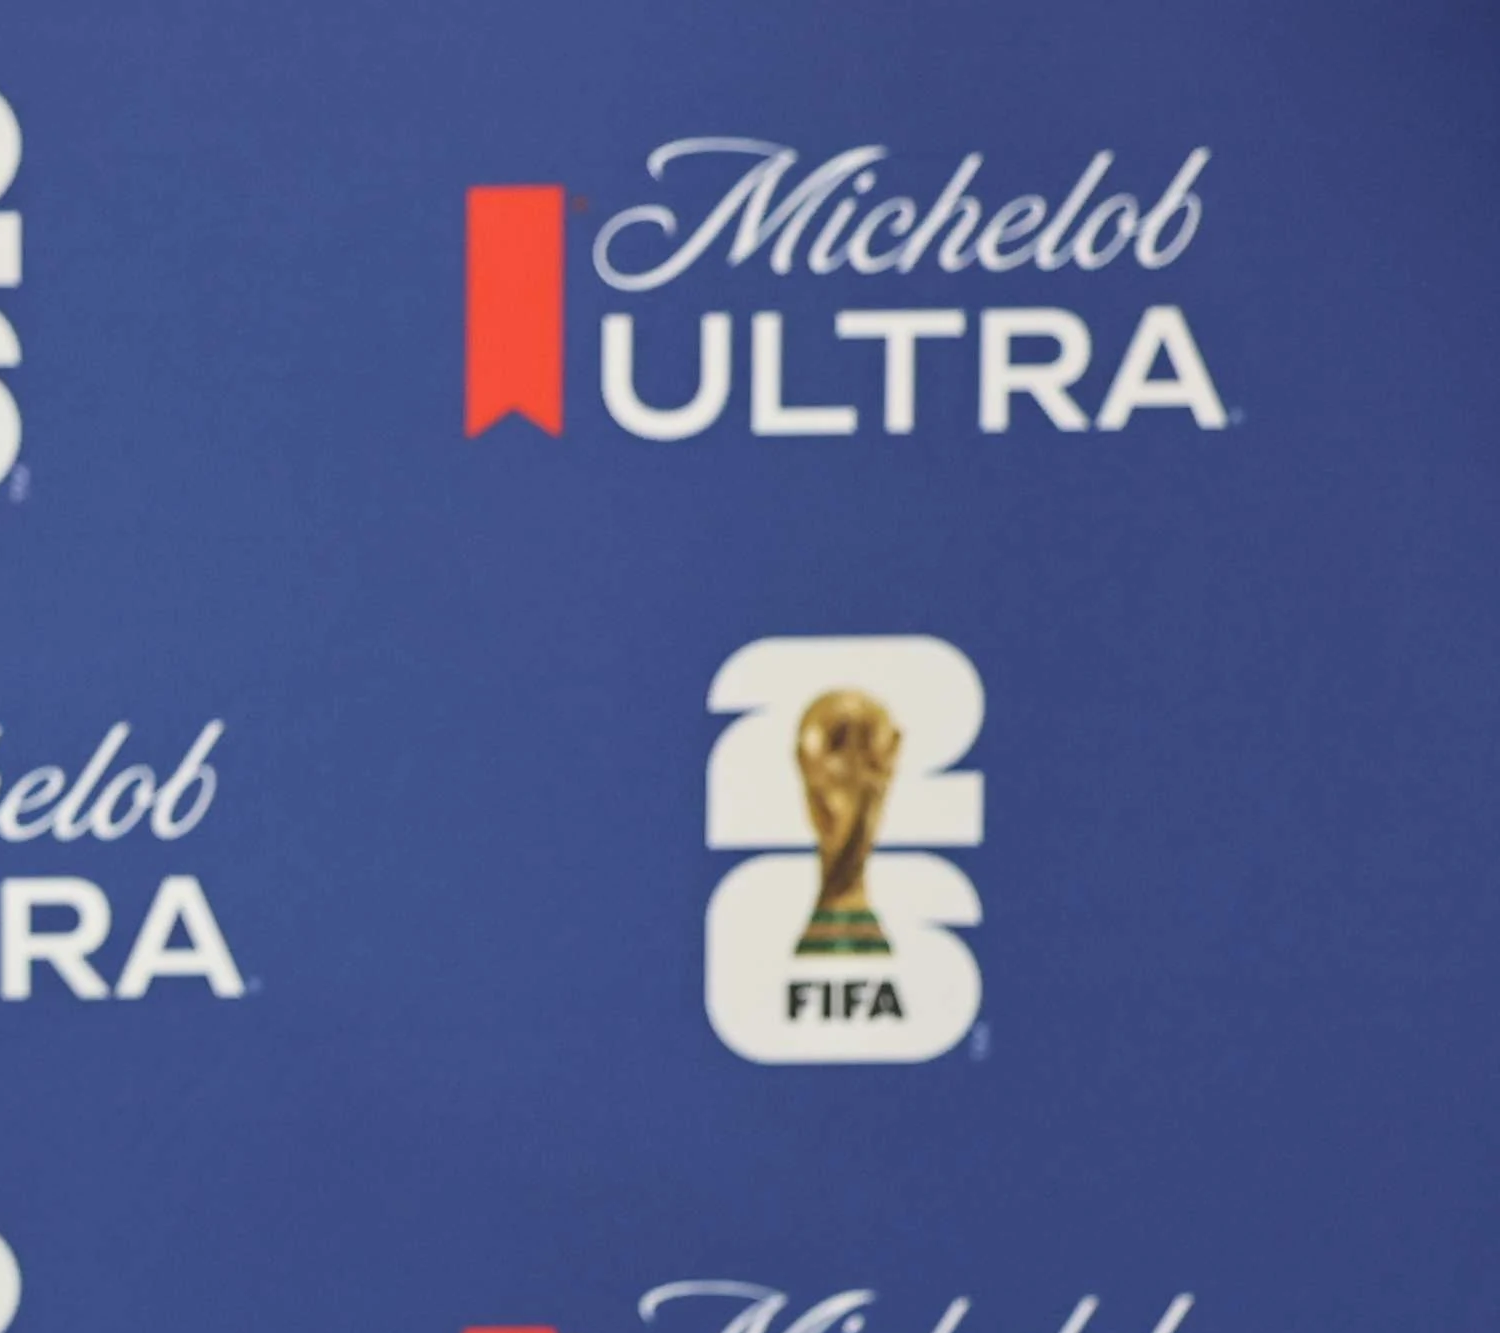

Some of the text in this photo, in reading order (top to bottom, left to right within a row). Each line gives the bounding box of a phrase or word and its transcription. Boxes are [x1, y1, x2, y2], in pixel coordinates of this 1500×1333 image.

[593, 138, 1209, 291] Michelob
[601, 306, 1228, 440] ULTRA
[788, 981, 903, 1019] FIFA
